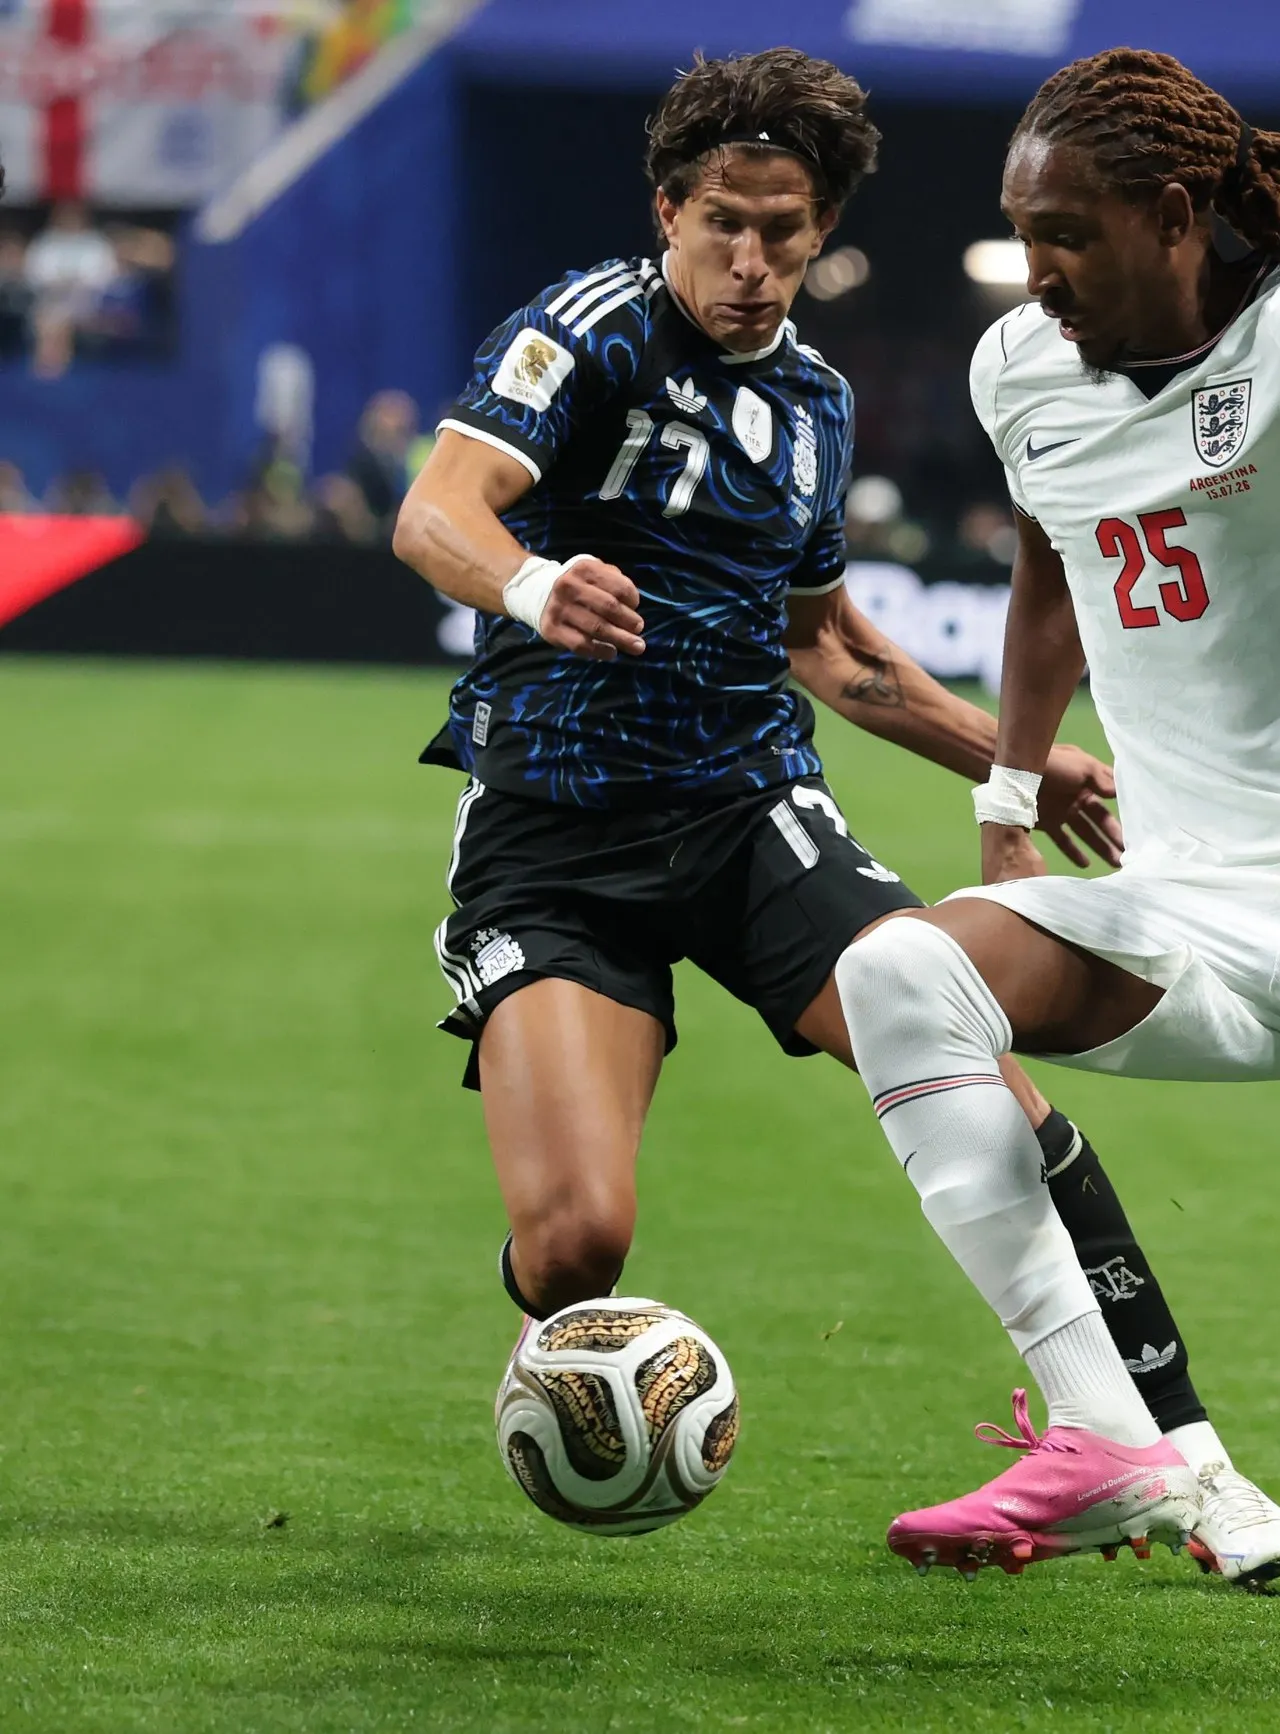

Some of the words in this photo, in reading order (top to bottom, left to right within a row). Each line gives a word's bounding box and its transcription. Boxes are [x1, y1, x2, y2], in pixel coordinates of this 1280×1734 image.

[598, 409, 710, 518] 17
[1189, 463, 1258, 491] ARGENTINA
[1206, 480, 1251, 500] 15.07.26
[1095, 507, 1210, 629] 25
[654, 1381, 688, 1428] YORK
